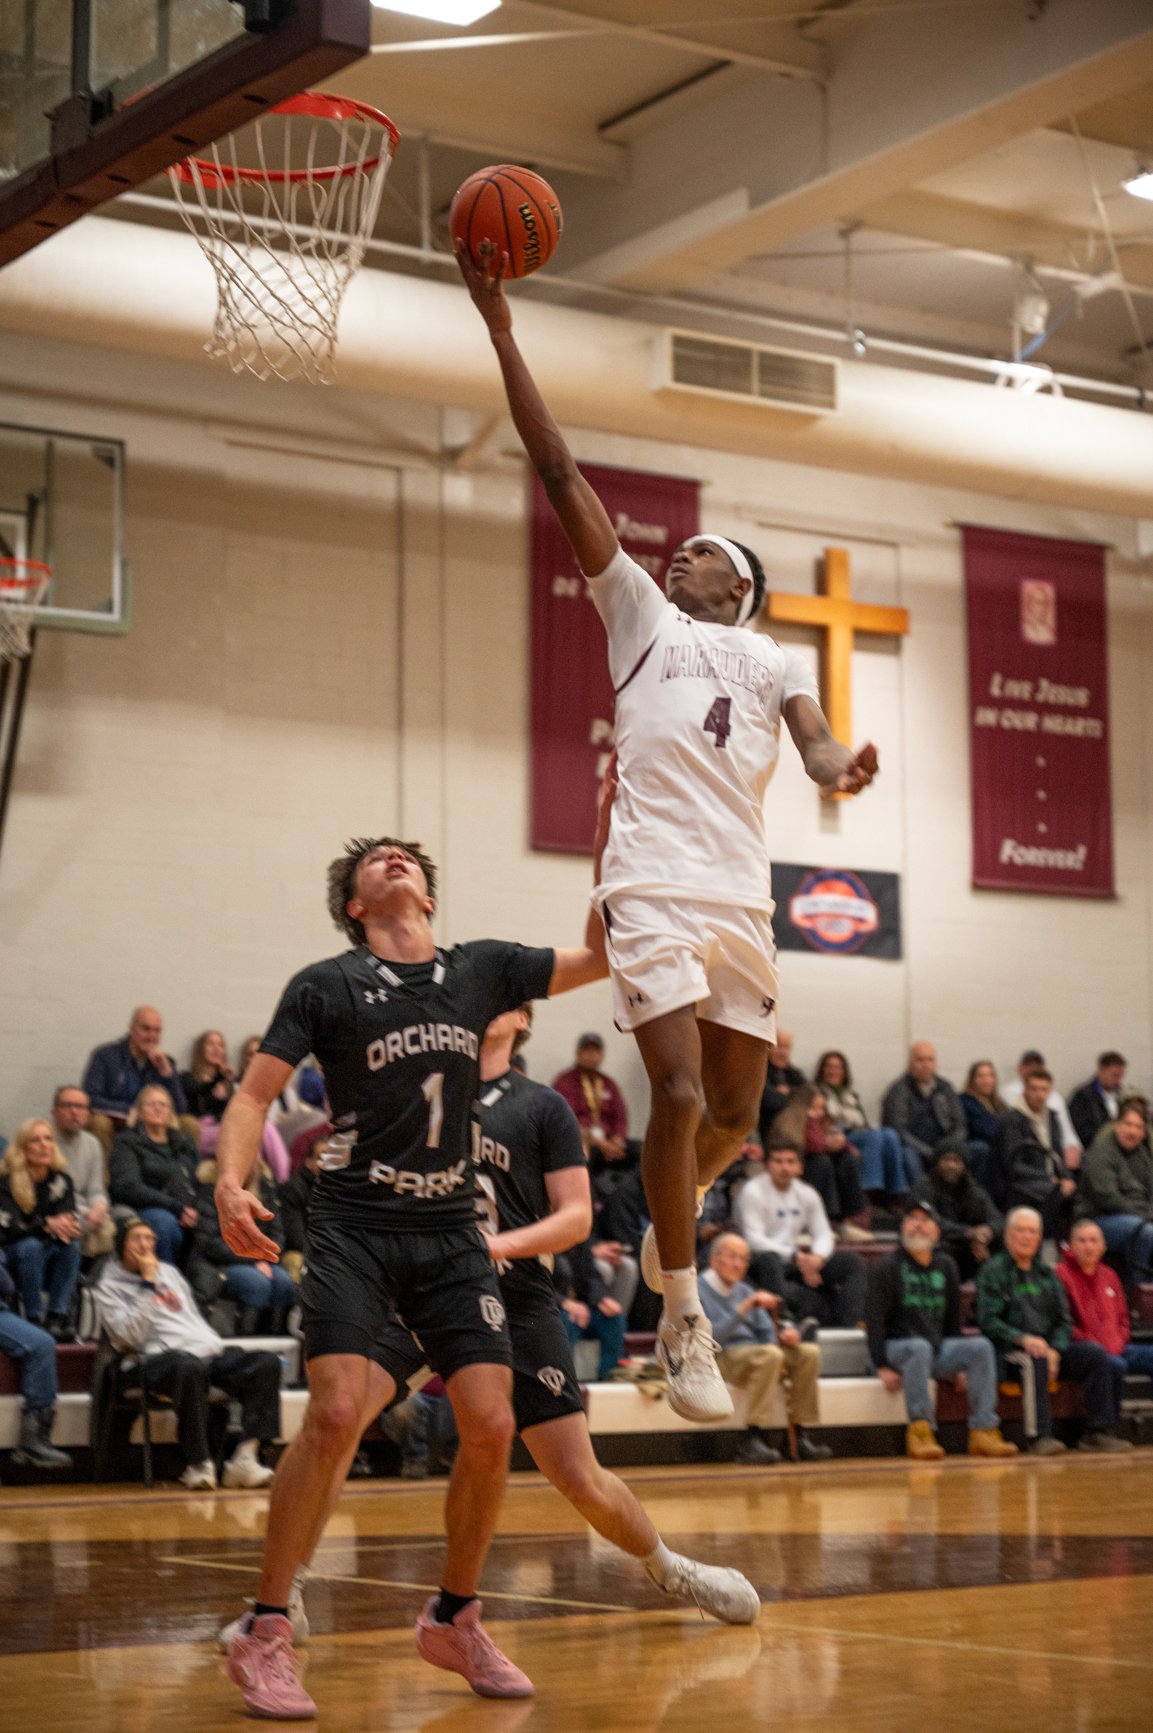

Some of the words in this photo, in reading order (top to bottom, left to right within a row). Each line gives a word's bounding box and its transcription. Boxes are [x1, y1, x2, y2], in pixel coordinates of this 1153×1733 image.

[518, 202, 542, 271] Wilson
[703, 697, 732, 748] 4
[367, 1023, 479, 1072] ORCHARD
[421, 1072, 445, 1149] 1
[368, 1159, 467, 1199] PARK
